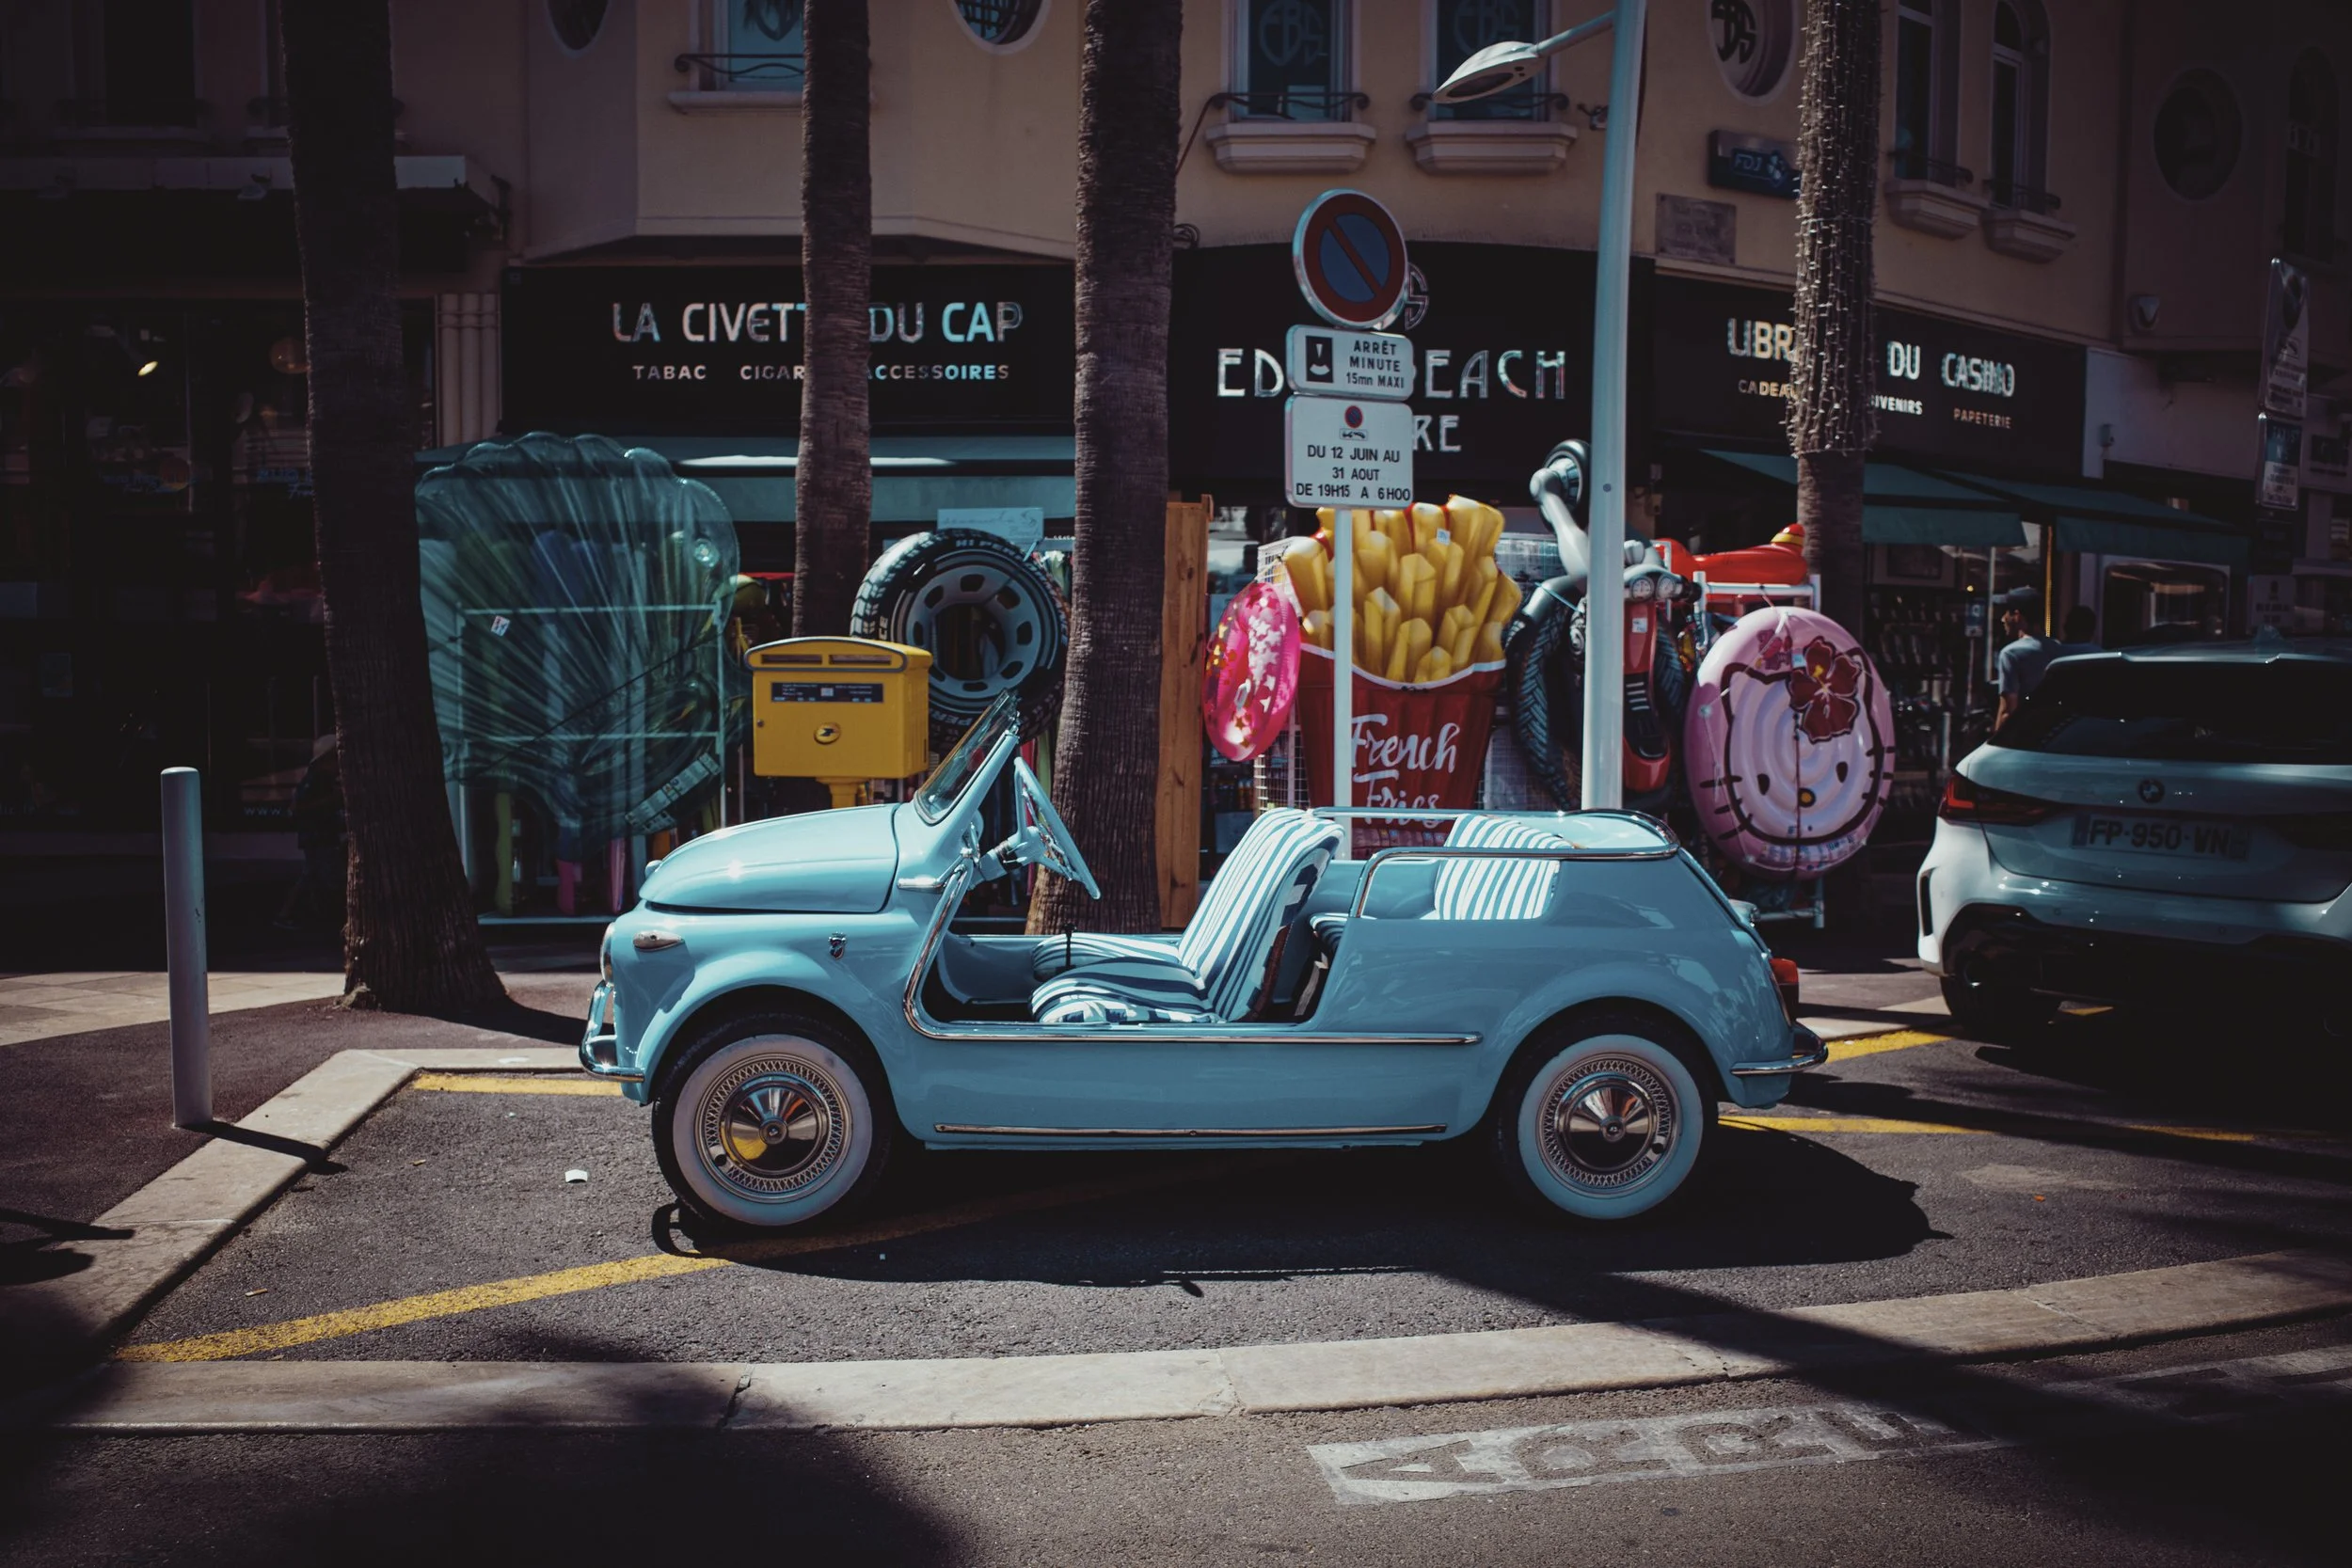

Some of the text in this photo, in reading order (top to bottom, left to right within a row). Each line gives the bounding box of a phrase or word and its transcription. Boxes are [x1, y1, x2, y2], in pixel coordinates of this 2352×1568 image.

[612, 301, 1024, 343] LA CIVET DU CAP
[1353, 340, 1397, 356] ARRÊT
[631, 364, 707, 380] TABAC
[739, 364, 805, 380] CIGAR
[1349, 356, 1401, 372] MINUTE
[1886, 341, 1921, 381] DU
[1940, 352, 2016, 398] CASINO
[1217, 348, 1565, 399] ED EACH
[1345, 372, 1405, 389] 15mn MAXI
[1738, 379, 2012, 429] CADEA UVENIRS PAPETERIE
[1307, 445, 1400, 463] DU 12 JUIN AU
[1332, 467, 1380, 481] 31 AOUT
[1295, 483, 1313, 497] DE
[1318, 483, 1351, 498] 19H15
[1360, 487, 1370, 499] A
[1351, 713, 1461, 773] French
